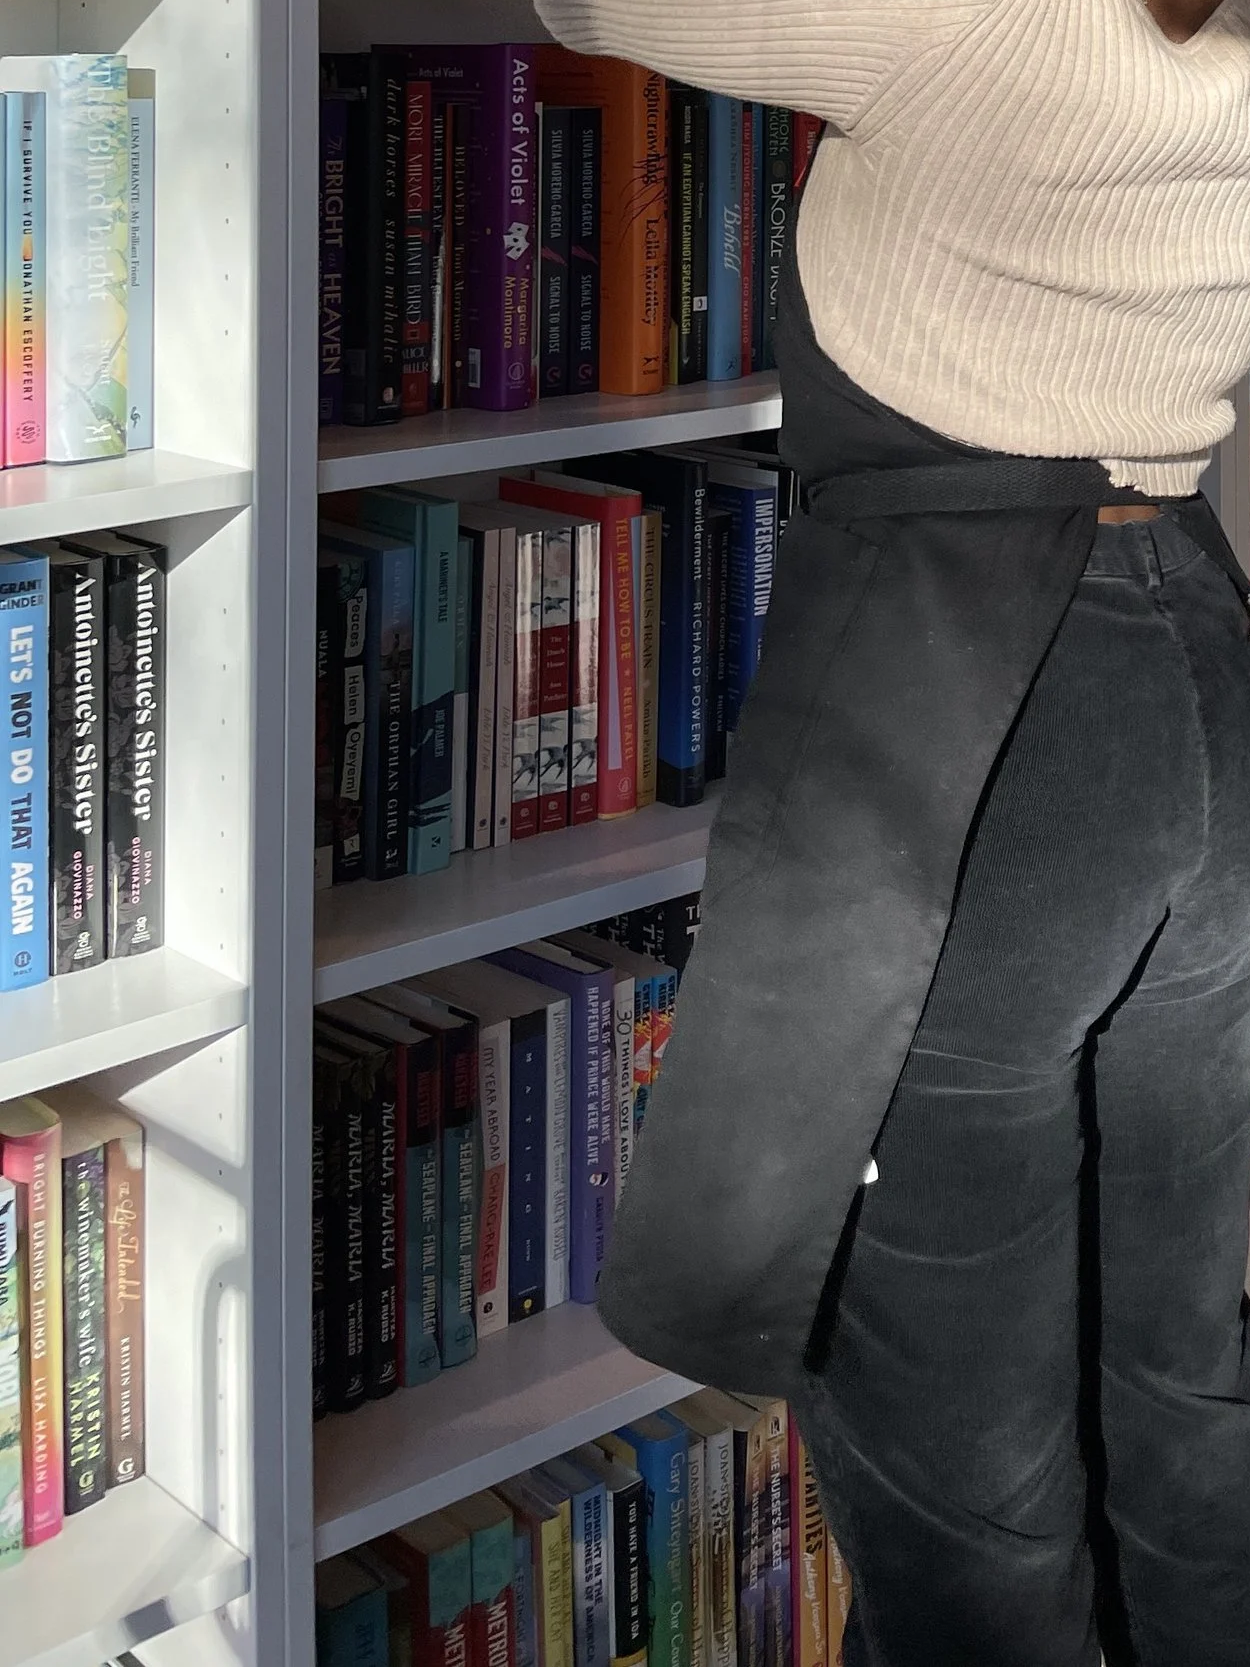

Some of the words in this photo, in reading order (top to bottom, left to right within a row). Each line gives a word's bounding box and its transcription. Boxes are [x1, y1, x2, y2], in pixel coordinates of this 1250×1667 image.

[512, 59, 529, 105] Acts
[23, 120, 33, 135] IF
[512, 112, 528, 136] of
[22, 149, 33, 203] SURVIVE
[511, 140, 529, 207] Violet
[22, 206, 34, 234] YOU
[22, 256, 33, 324] JONATHAN
[503, 276, 514, 349] Montimore
[518, 277, 530, 346] Margarita
[580, 309, 592, 321] TO
[581, 275, 592, 308] SIGNAL
[22, 329, 34, 403] ESCOFFERY
[580, 324, 592, 351] NOISE
[693, 487, 706, 581] Bewilderment
[350, 596, 363, 649] Peaces
[691, 601, 703, 677] RICHARD
[10, 625, 34, 682] LET'S
[74, 574, 97, 737] Antoinette's
[11, 691, 32, 738] NOT
[348, 674, 360, 718] Helen
[690, 684, 702, 753] POWERS
[11, 747, 34, 784] DO
[74, 743, 97, 835] Sister
[344, 730, 361, 794] Oyeyemi
[11, 793, 32, 850] THAT
[11, 862, 34, 935] AGAIN
[616, 1010, 632, 1035] 30
[620, 1038, 630, 1088] THINGS
[380, 1100, 396, 1185] MARIA,
[620, 1099, 629, 1134] LOVE
[33, 1152, 45, 1213] BRIGHT
[32, 1216, 45, 1295] BURNING
[75, 1195, 94, 1323] winemaker's
[381, 1191, 395, 1269] MARIA
[32, 1299, 45, 1359] THINGS
[77, 1324, 97, 1369] wife
[68, 1381, 82, 1468] HARMEL
[87, 1372, 100, 1461] KRISTIN
